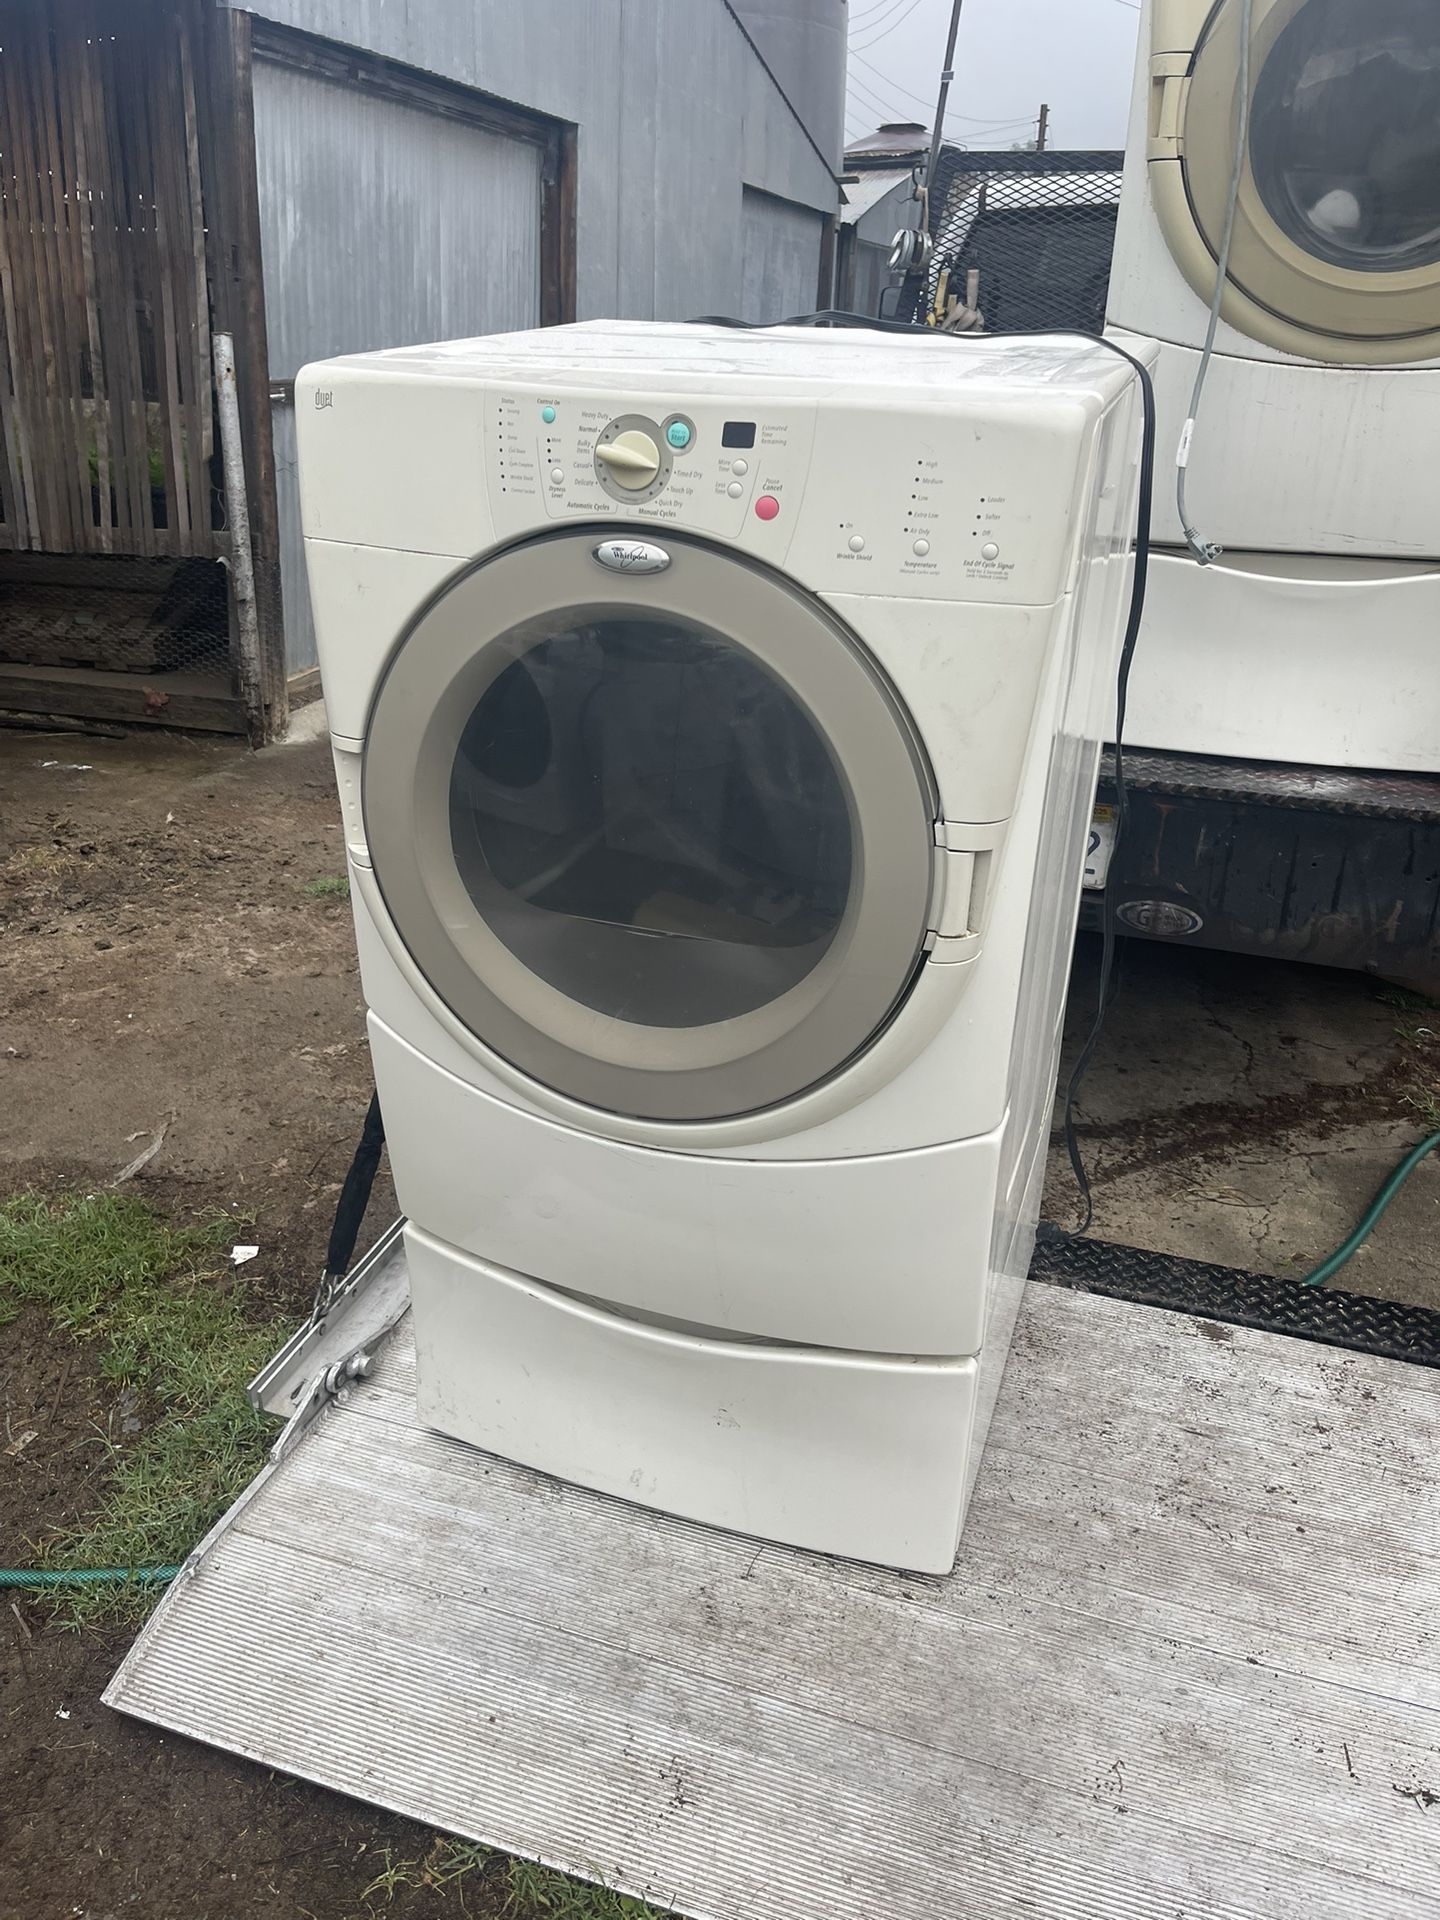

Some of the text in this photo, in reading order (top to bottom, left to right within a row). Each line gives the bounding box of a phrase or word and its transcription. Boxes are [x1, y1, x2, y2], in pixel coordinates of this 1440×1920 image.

[582, 411, 609, 421] Heavy Duty
[579, 425, 597, 433] Normal
[693, 471, 703, 479] Dry
[574, 478, 594, 486] Delicate
[567, 501, 610, 511] Automatic Cycles
[638, 508, 676, 518] Manual Cycles
[613, 551, 648, 561] Whirlpool
[904, 560, 937, 568] Temperature
